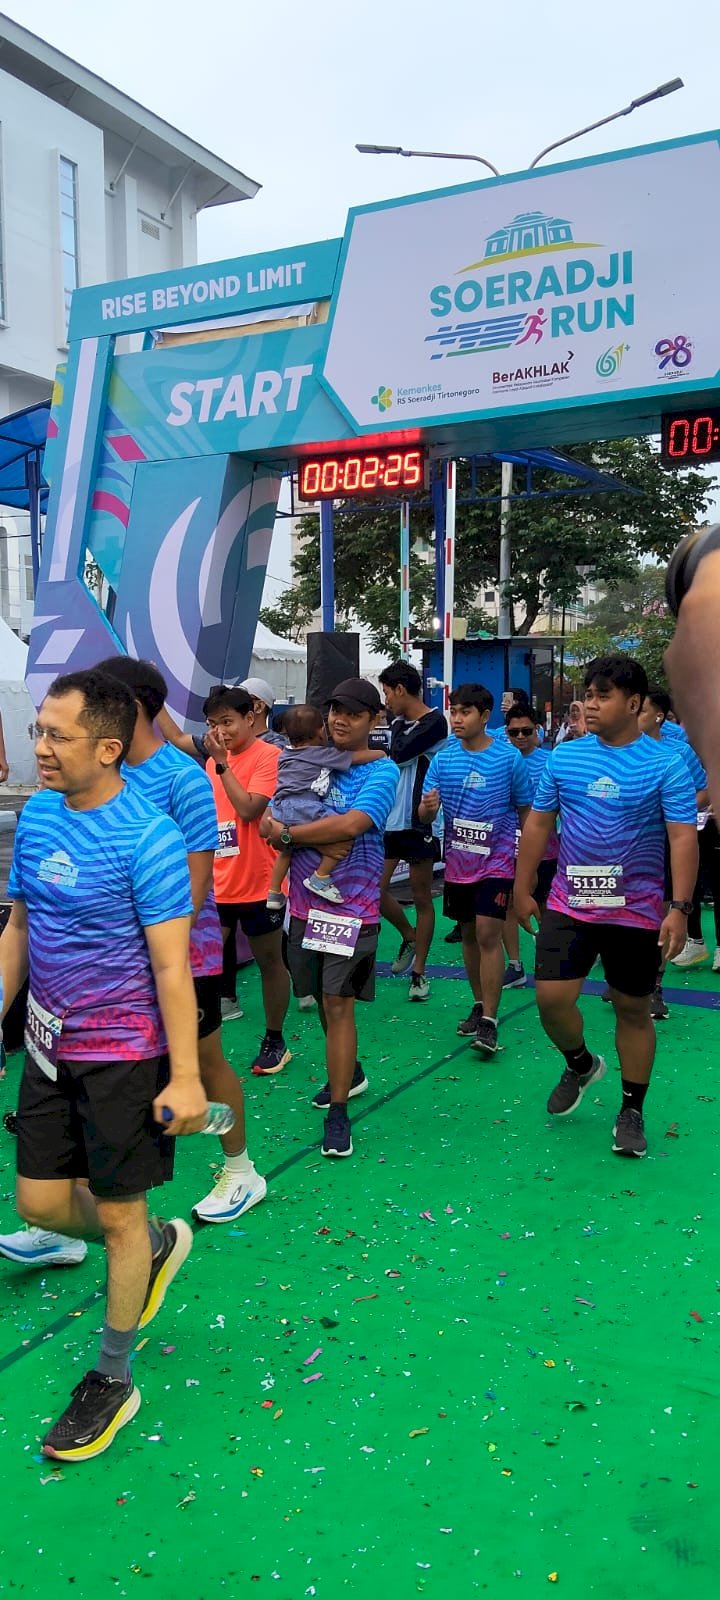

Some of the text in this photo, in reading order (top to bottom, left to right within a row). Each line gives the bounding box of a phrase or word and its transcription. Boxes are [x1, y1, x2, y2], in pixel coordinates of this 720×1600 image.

[102, 262, 306, 320] RISE BEYOND LIMIT
[429, 250, 633, 317] SOERADJI
[551, 294, 634, 338] RUN
[492, 361, 570, 384] BerAKHLAK
[166, 364, 314, 426] START
[397, 384, 442, 396] Kemenkes
[408, 394, 436, 404] Soeradji
[437, 388, 480, 399] Tirtonegoro
[303, 452, 420, 494] 00:02:25
[456, 827, 487, 841] 51310
[573, 877, 617, 889] 51128
[312, 921, 352, 939] 51274
